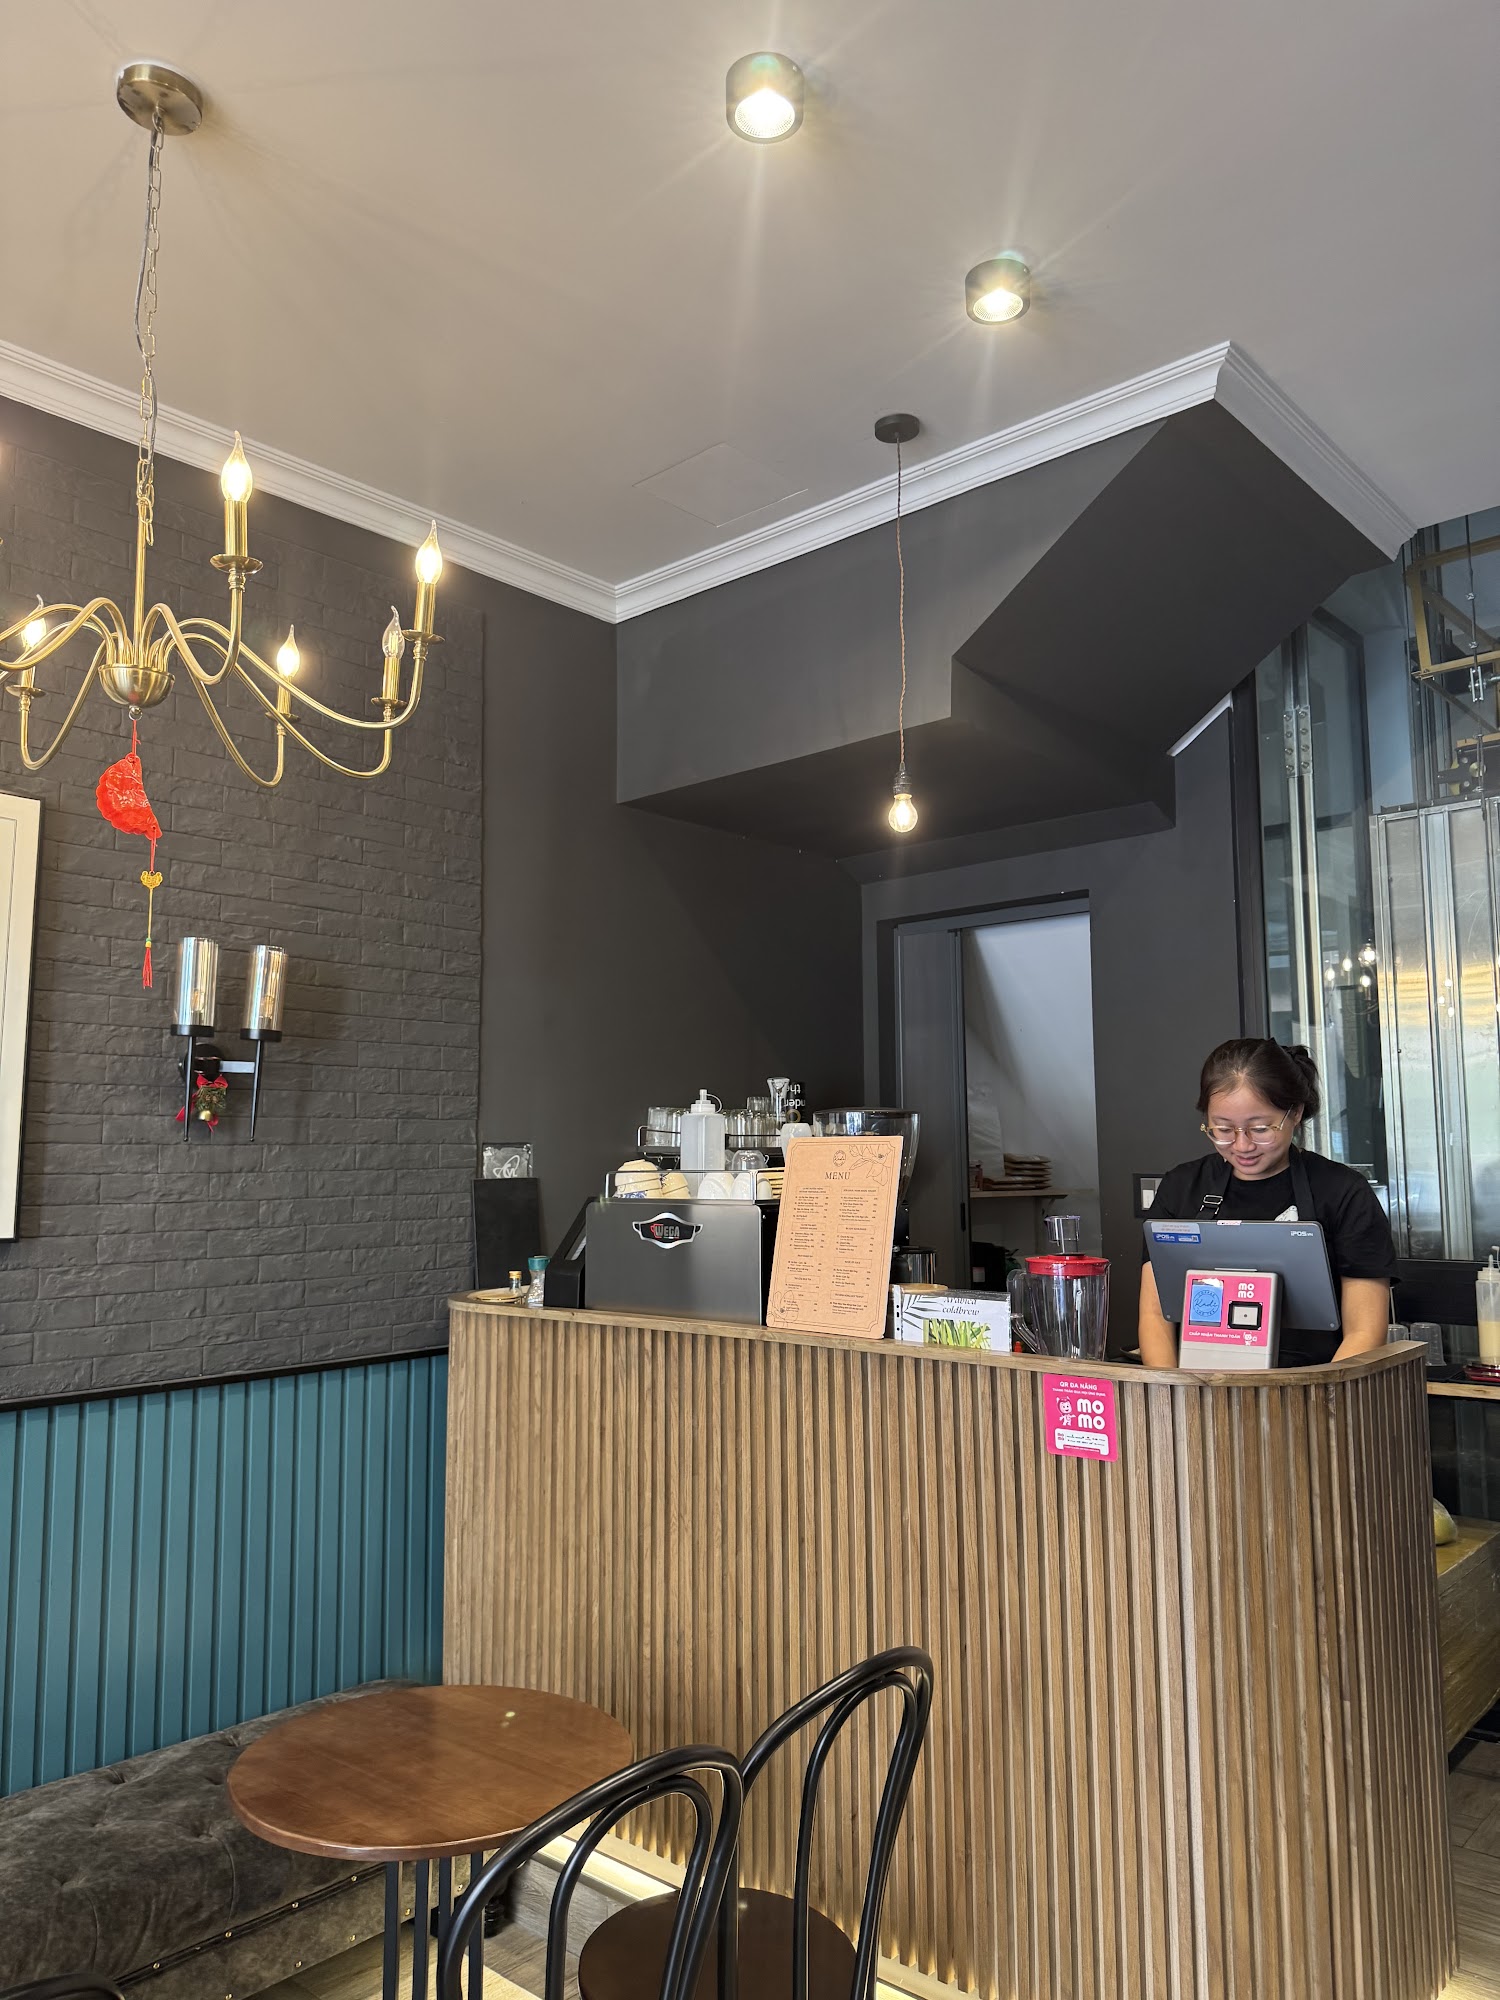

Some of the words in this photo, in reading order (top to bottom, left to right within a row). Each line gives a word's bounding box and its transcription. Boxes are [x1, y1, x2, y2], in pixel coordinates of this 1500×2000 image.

[825, 1171, 851, 1180] MENU
[655, 1225, 680, 1237] WEGA
[942, 1306, 979, 1315] coldbrew
